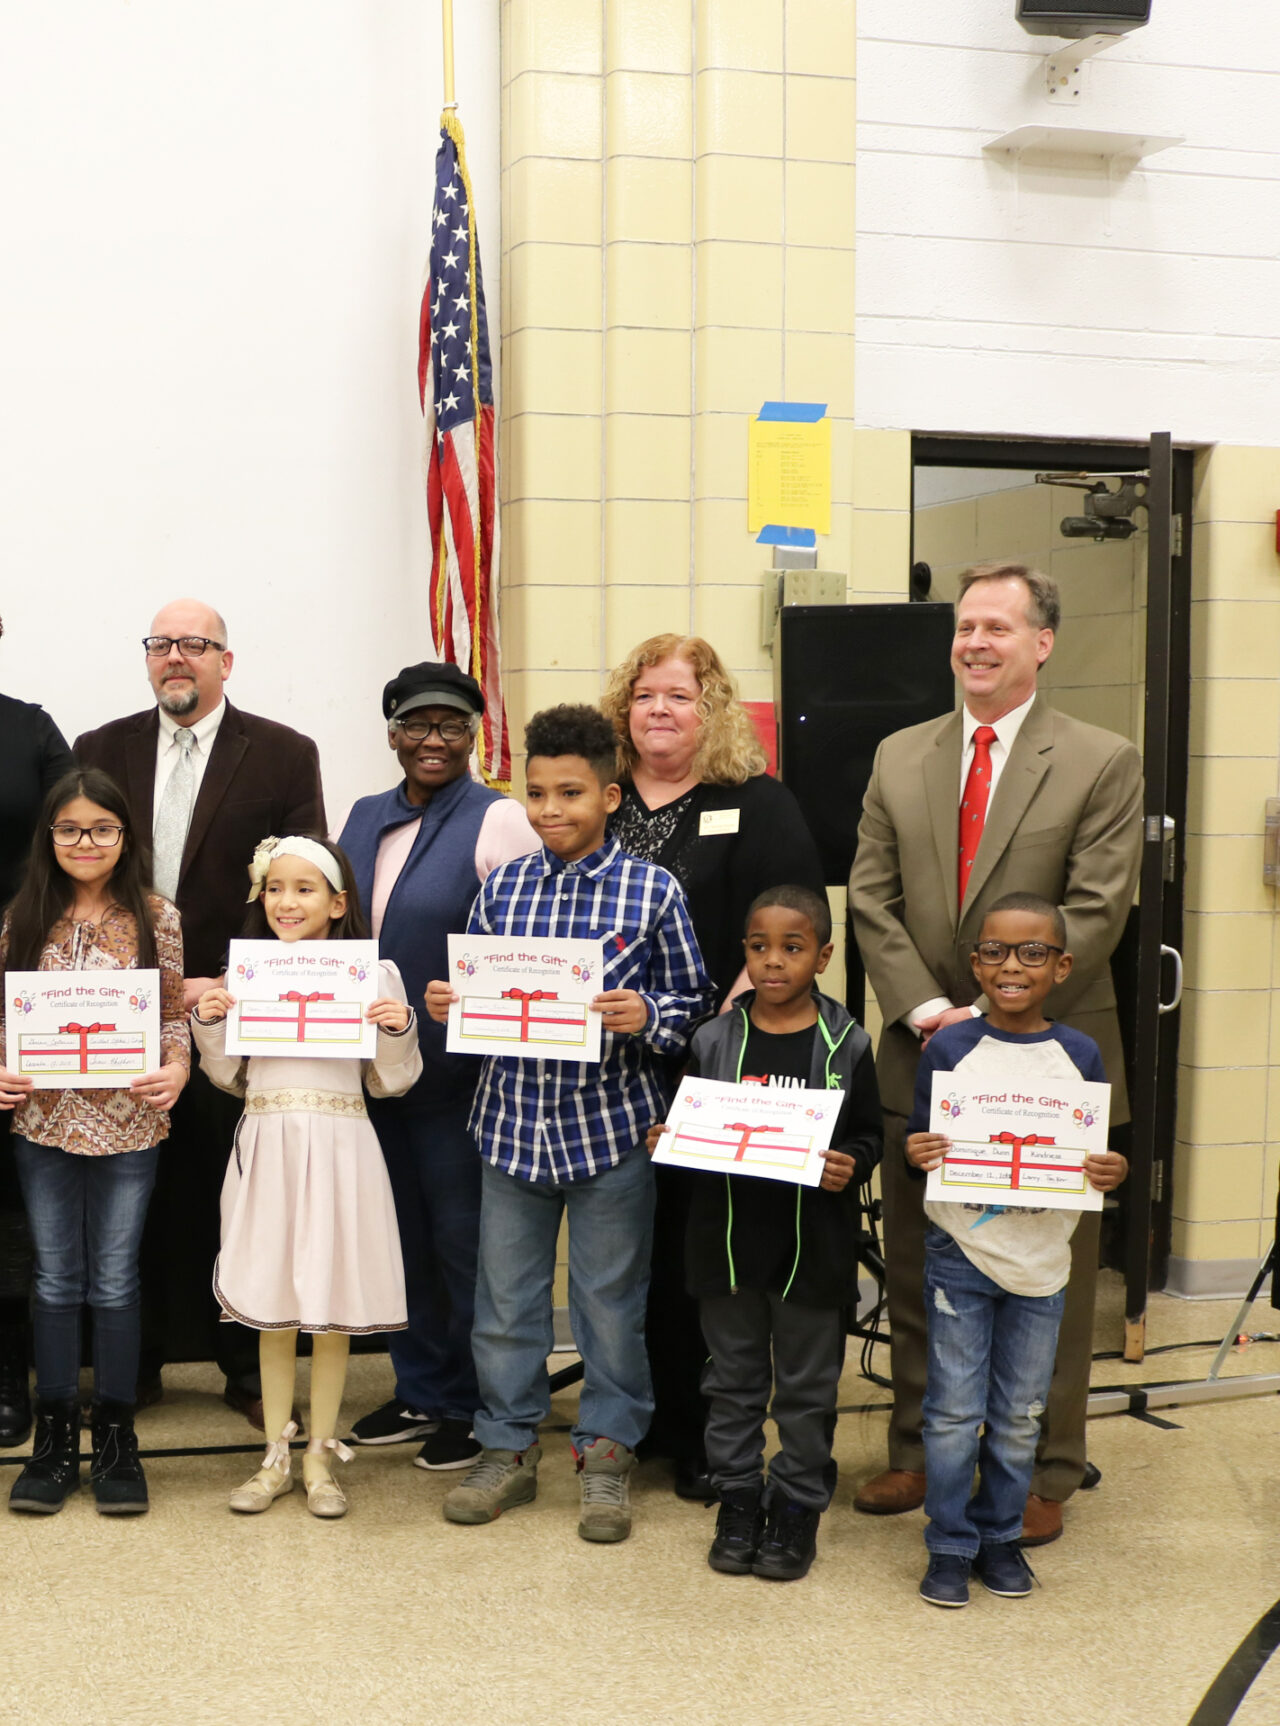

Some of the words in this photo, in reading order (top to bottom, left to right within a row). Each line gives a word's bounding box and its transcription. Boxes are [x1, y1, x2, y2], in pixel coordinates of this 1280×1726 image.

[264, 957, 293, 967] "Find
[297, 956, 316, 964] the
[320, 957, 344, 968] Gift"
[484, 953, 513, 963] "Find
[518, 953, 537, 962] the
[541, 955, 567, 967] Gift"
[529, 968, 560, 976] Recognition
[41, 987, 71, 999] "Find
[76, 987, 94, 995] the
[99, 988, 125, 998] Gift"
[972, 1093, 1007, 1104] "Find
[1012, 1094, 1034, 1104] the
[1039, 1097, 1069, 1110] Gift"
[981, 1107, 1013, 1115] Certificate
[1023, 1110, 1060, 1119] Recognition
